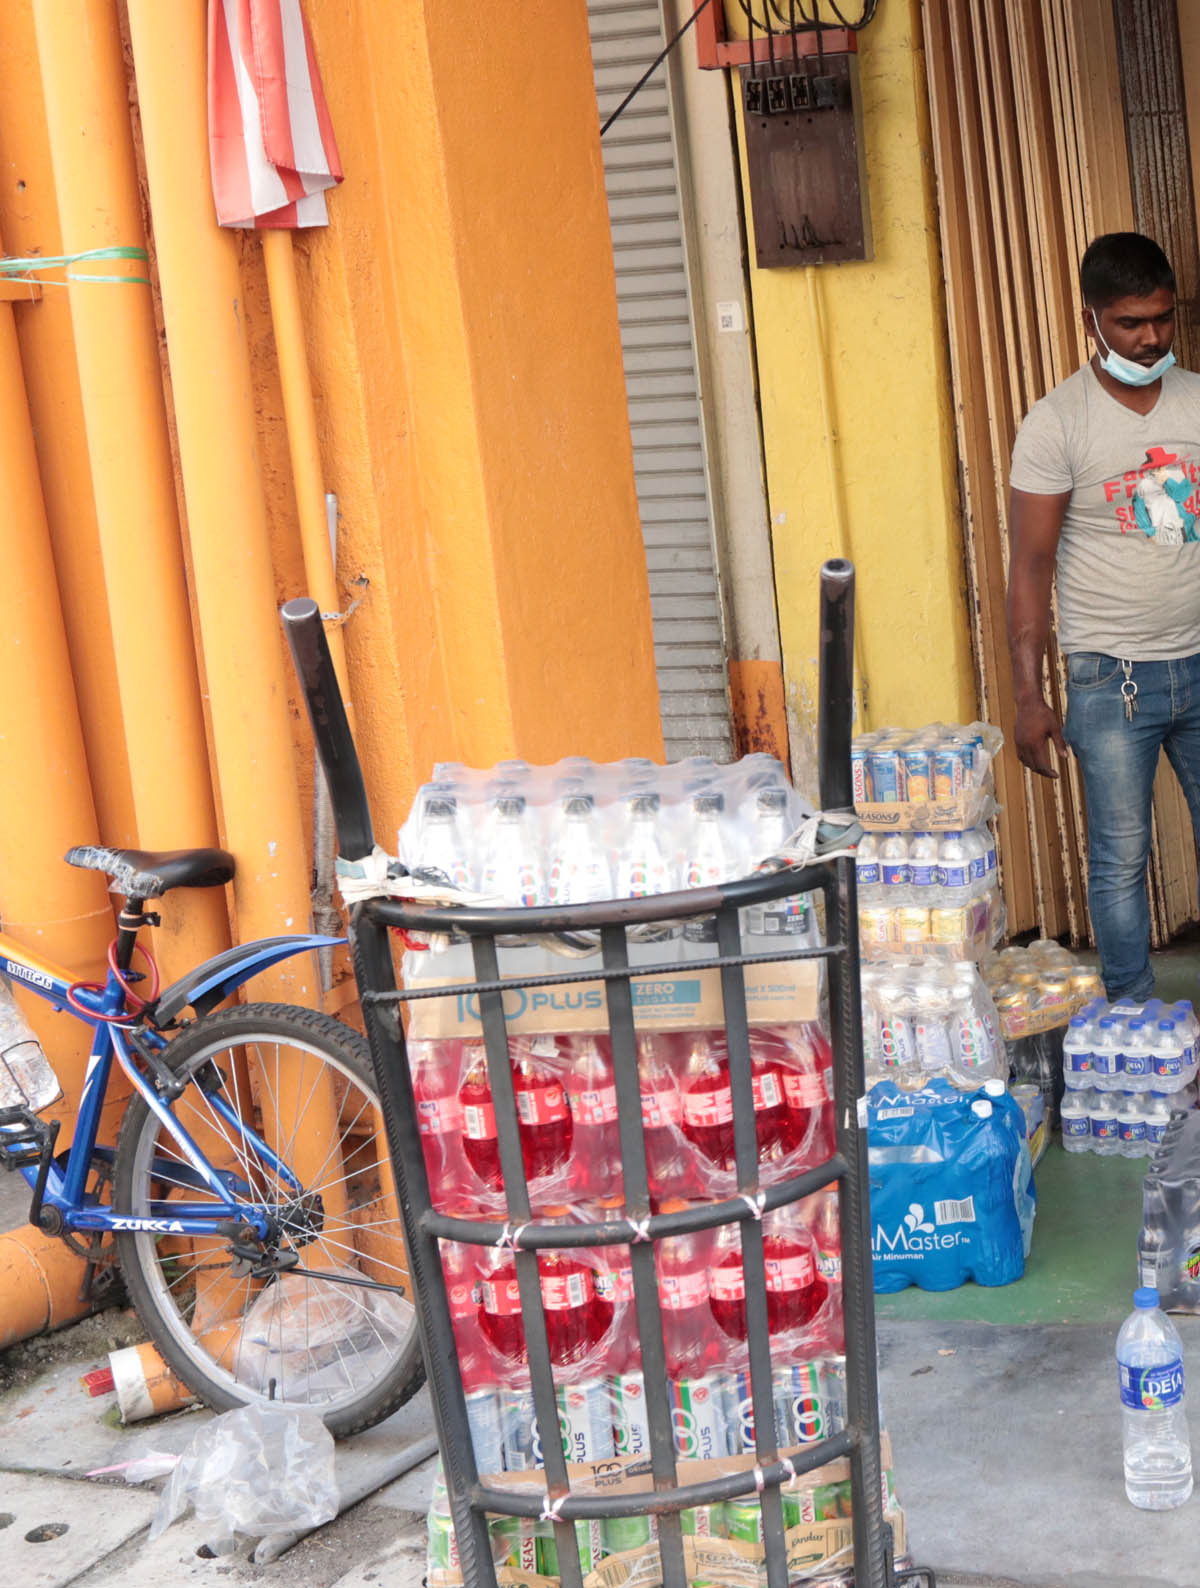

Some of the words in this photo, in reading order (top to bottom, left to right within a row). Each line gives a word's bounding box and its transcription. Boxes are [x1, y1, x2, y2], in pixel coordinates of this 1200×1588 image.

[531, 991, 603, 1011] PLUS
[636, 983, 675, 996] ZERO
[871, 1224, 962, 1251] Master
[884, 1252, 924, 1261] Minuman
[671, 1408, 699, 1456] 00
[701, 1426, 711, 1460] PLUS
[575, 1432, 586, 1464] PLUS
[594, 1477, 622, 1488] PLUS
[522, 1536, 535, 1572] SEAS
